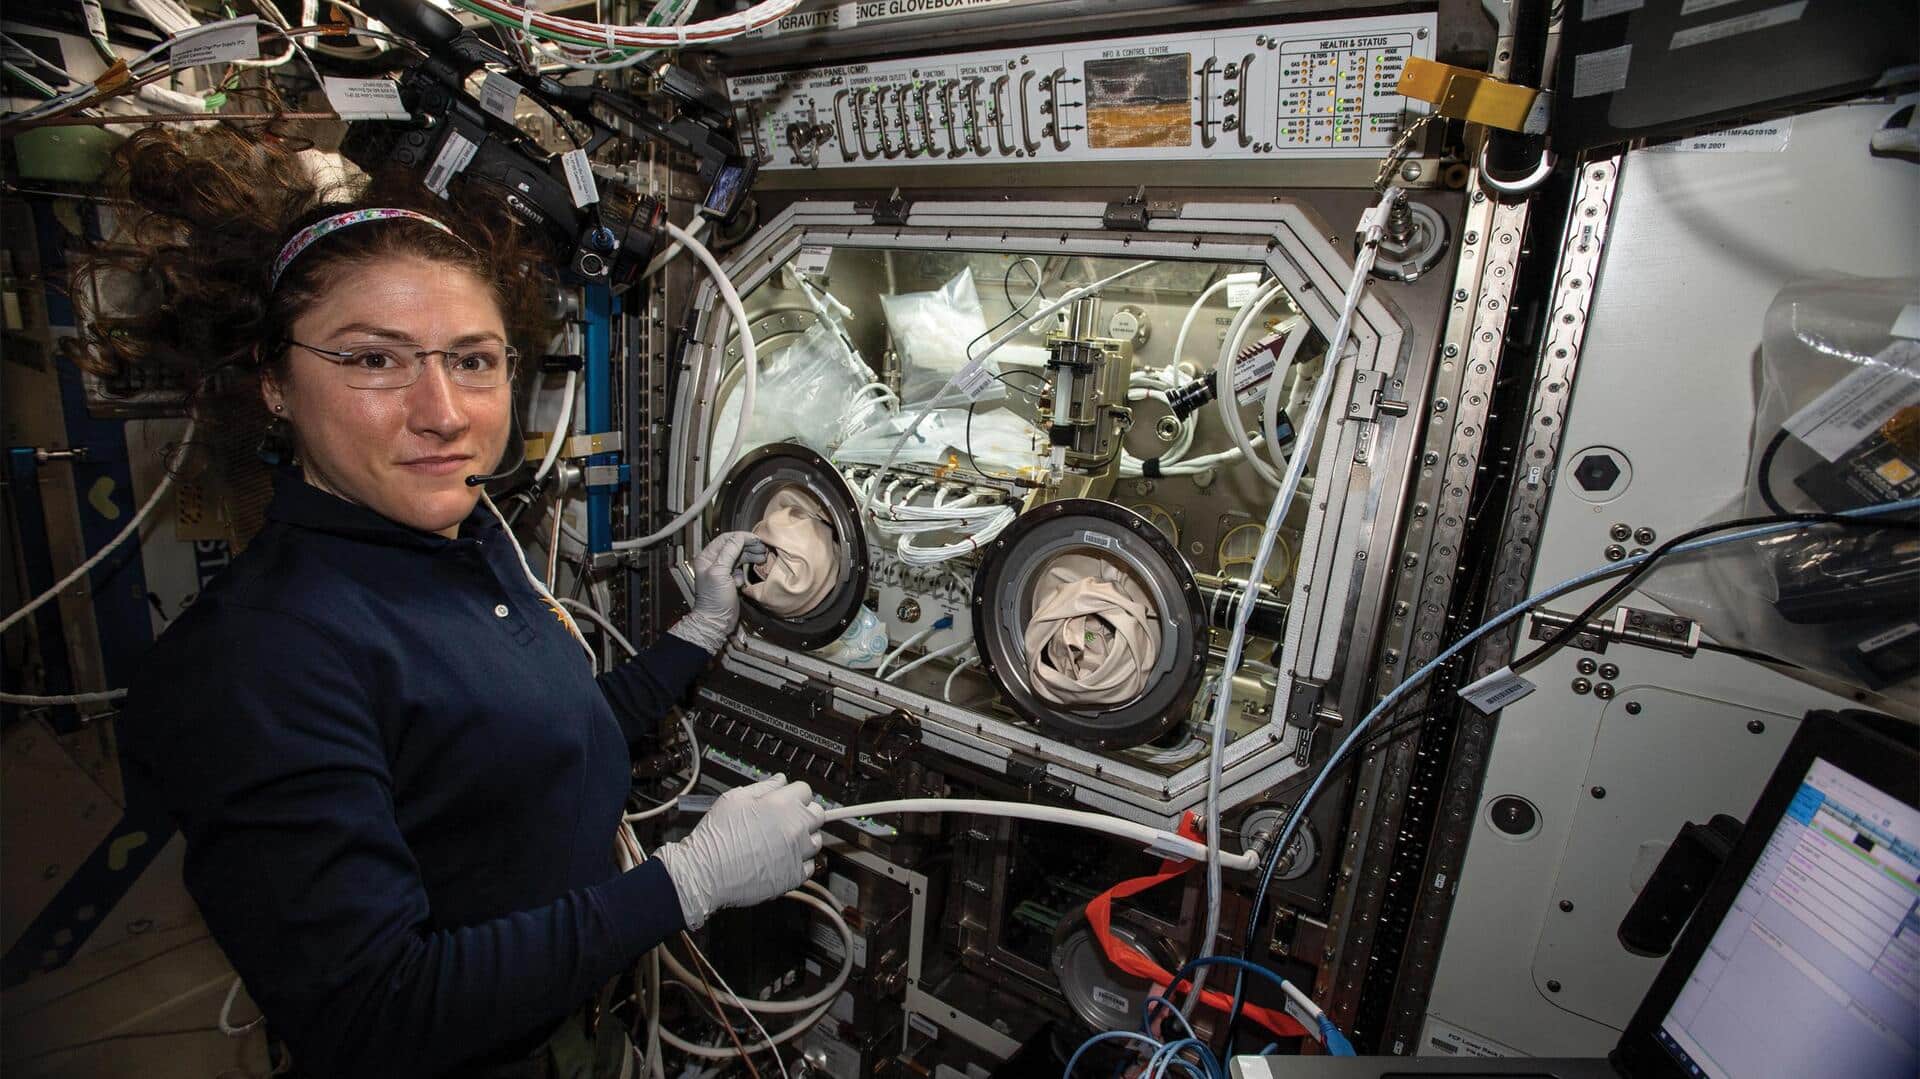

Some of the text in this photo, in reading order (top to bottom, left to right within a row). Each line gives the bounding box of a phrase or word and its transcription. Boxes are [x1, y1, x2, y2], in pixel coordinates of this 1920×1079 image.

[1122, 48, 1146, 56] CONTROL
[1320, 38, 1388, 50] HEALTH & STATUS
[733, 75, 766, 87] COMMAND
[824, 66, 848, 78] PANEL
[848, 64, 869, 75] (CMP)
[979, 66, 1004, 74] FUNCTIONS
[507, 194, 544, 224] Canon
[720, 696, 843, 752] POWER DISTRIBUTION AND CONVERSION
